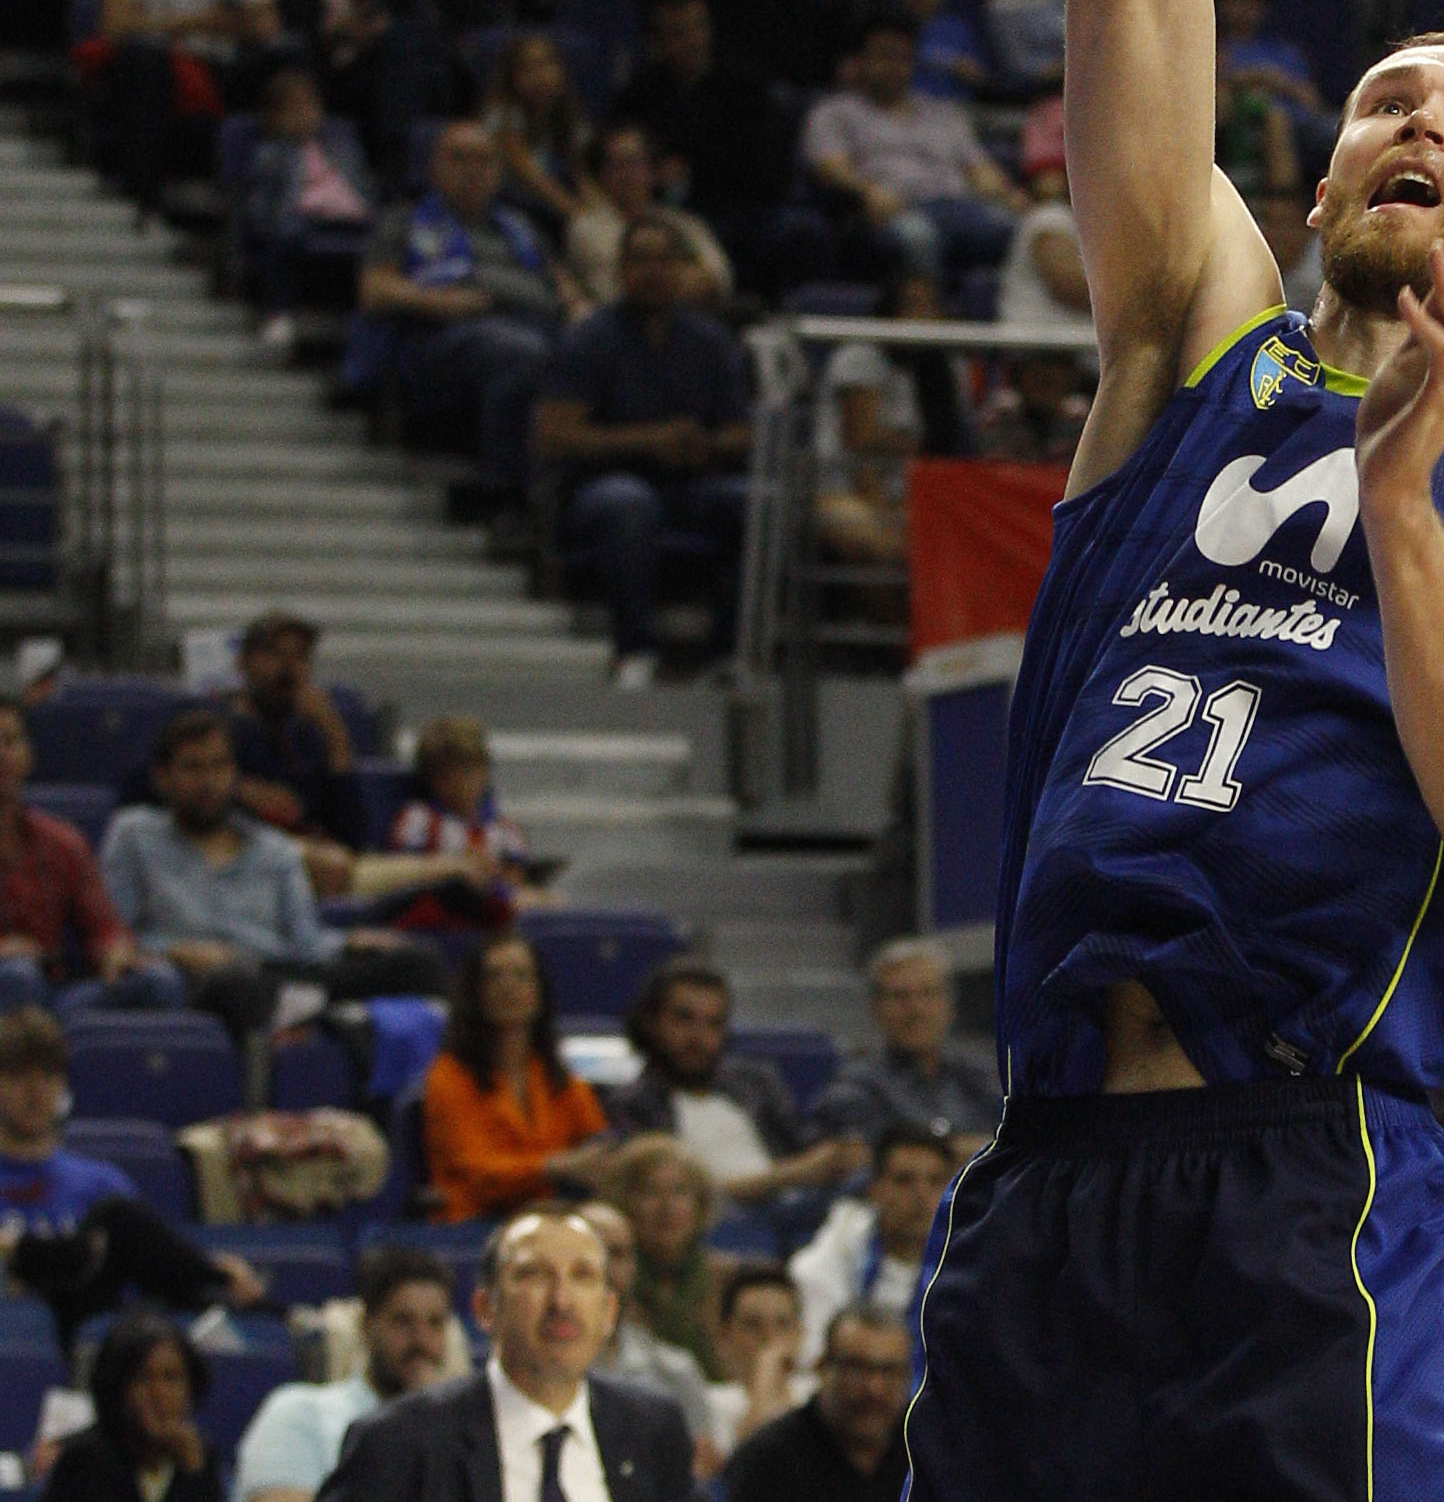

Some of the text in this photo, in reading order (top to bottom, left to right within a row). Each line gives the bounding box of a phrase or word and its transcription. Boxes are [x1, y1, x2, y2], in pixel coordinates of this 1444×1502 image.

[1119, 581, 1342, 651] studiantes
[1258, 559, 1360, 611] movistar
[1083, 664, 1263, 813] 21
